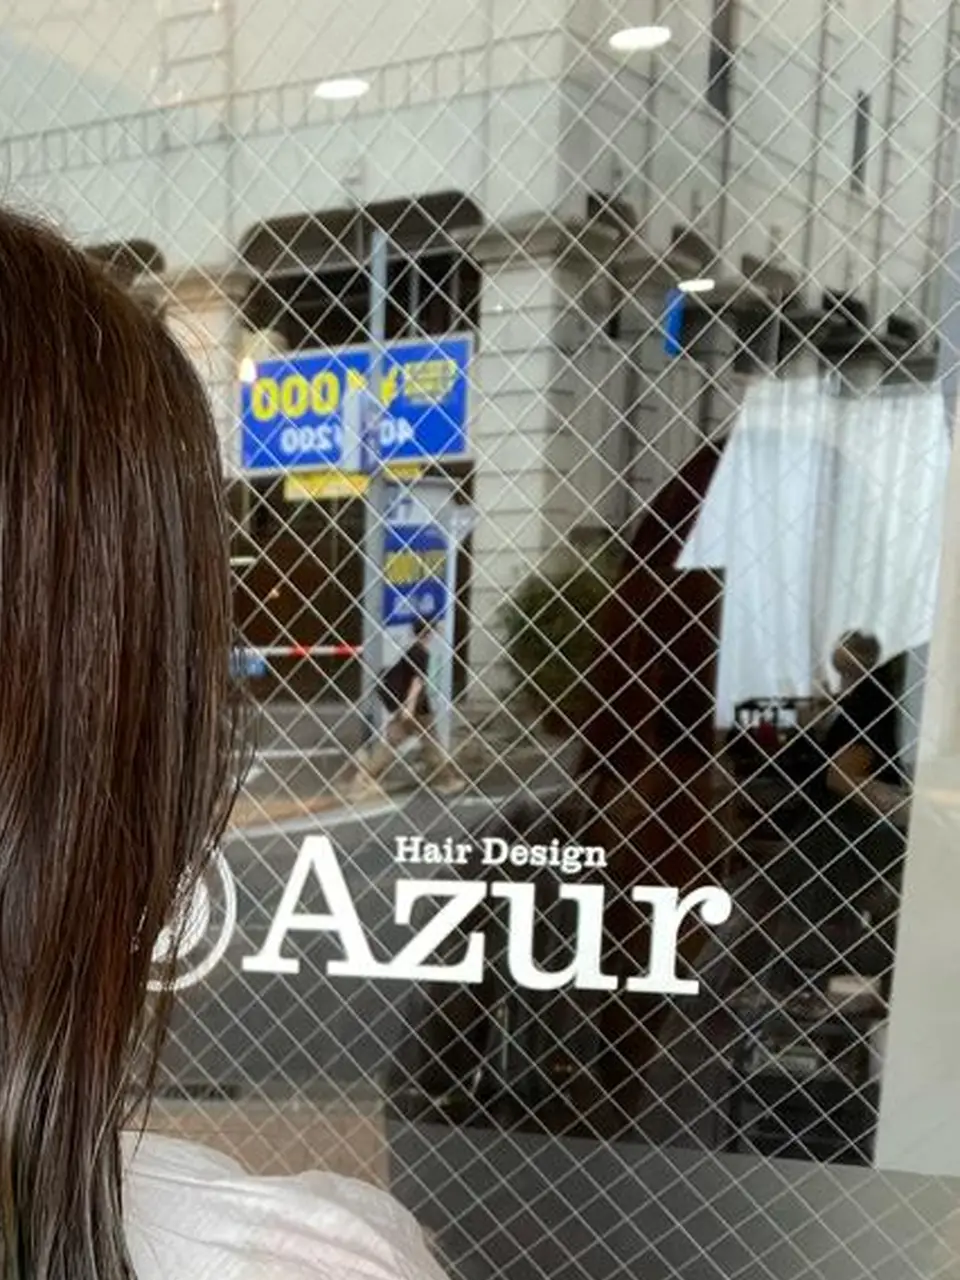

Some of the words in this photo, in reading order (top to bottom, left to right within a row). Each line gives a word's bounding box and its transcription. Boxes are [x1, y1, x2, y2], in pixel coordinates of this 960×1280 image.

[394, 835, 473, 866] Hair
[481, 837, 608, 876] Design
[241, 834, 732, 996] Azur
